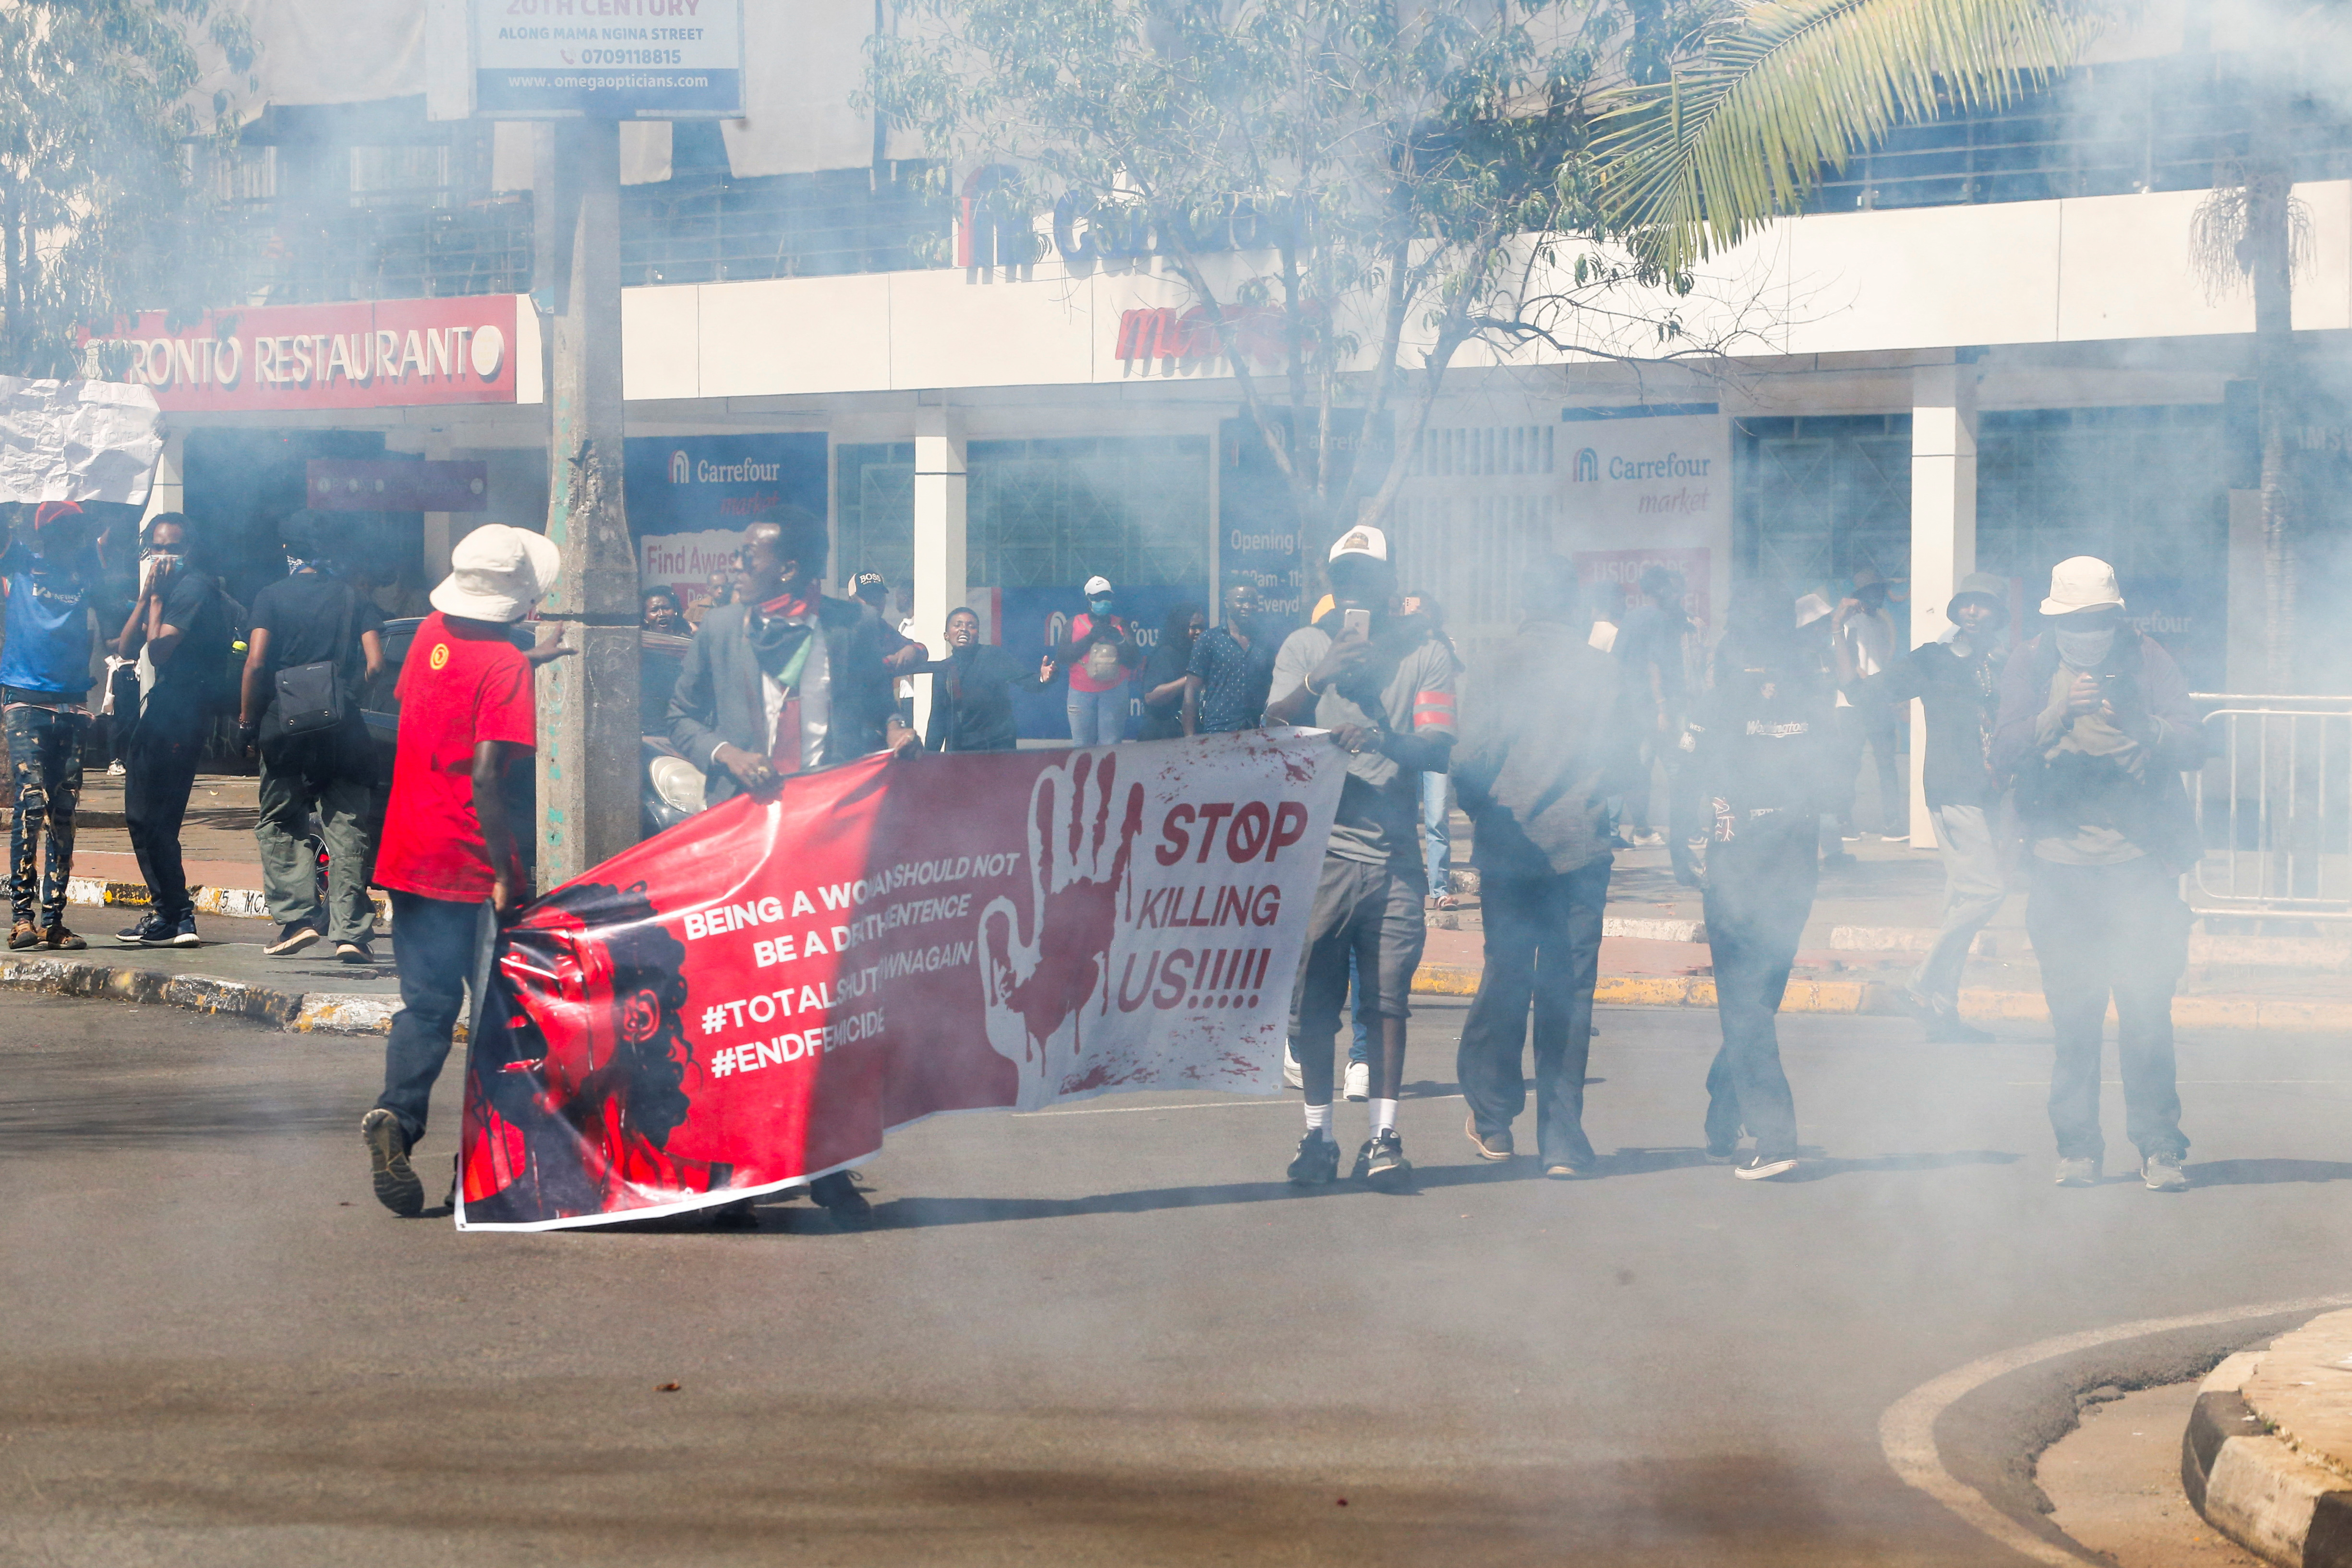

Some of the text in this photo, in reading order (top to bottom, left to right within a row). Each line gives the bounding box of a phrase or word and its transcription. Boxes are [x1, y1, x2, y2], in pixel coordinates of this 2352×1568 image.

[581, 0, 700, 16] CENTURY
[499, 27, 704, 40] ALONG MAMA NGINA STREET
[581, 49, 681, 65] 0709118815
[698, 458, 780, 482] Carrefour
[1609, 452, 1711, 480] Carrefour
[1638, 486, 1710, 515] market
[1231, 529, 1293, 555] Opening
[647, 545, 686, 574] Find
[859, 573, 881, 583] BOSS
[1155, 801, 1309, 867] STOP
[684, 895, 784, 941] BEING
[791, 890, 816, 917] A
[892, 856, 970, 889] SHOULD
[972, 853, 1021, 879] NOT
[1136, 884, 1281, 929] KILLING
[753, 935, 797, 968] BE
[803, 930, 828, 958] A
[887, 893, 972, 929] ENTENCE
[1118, 948, 1272, 1013] US!!!!!
